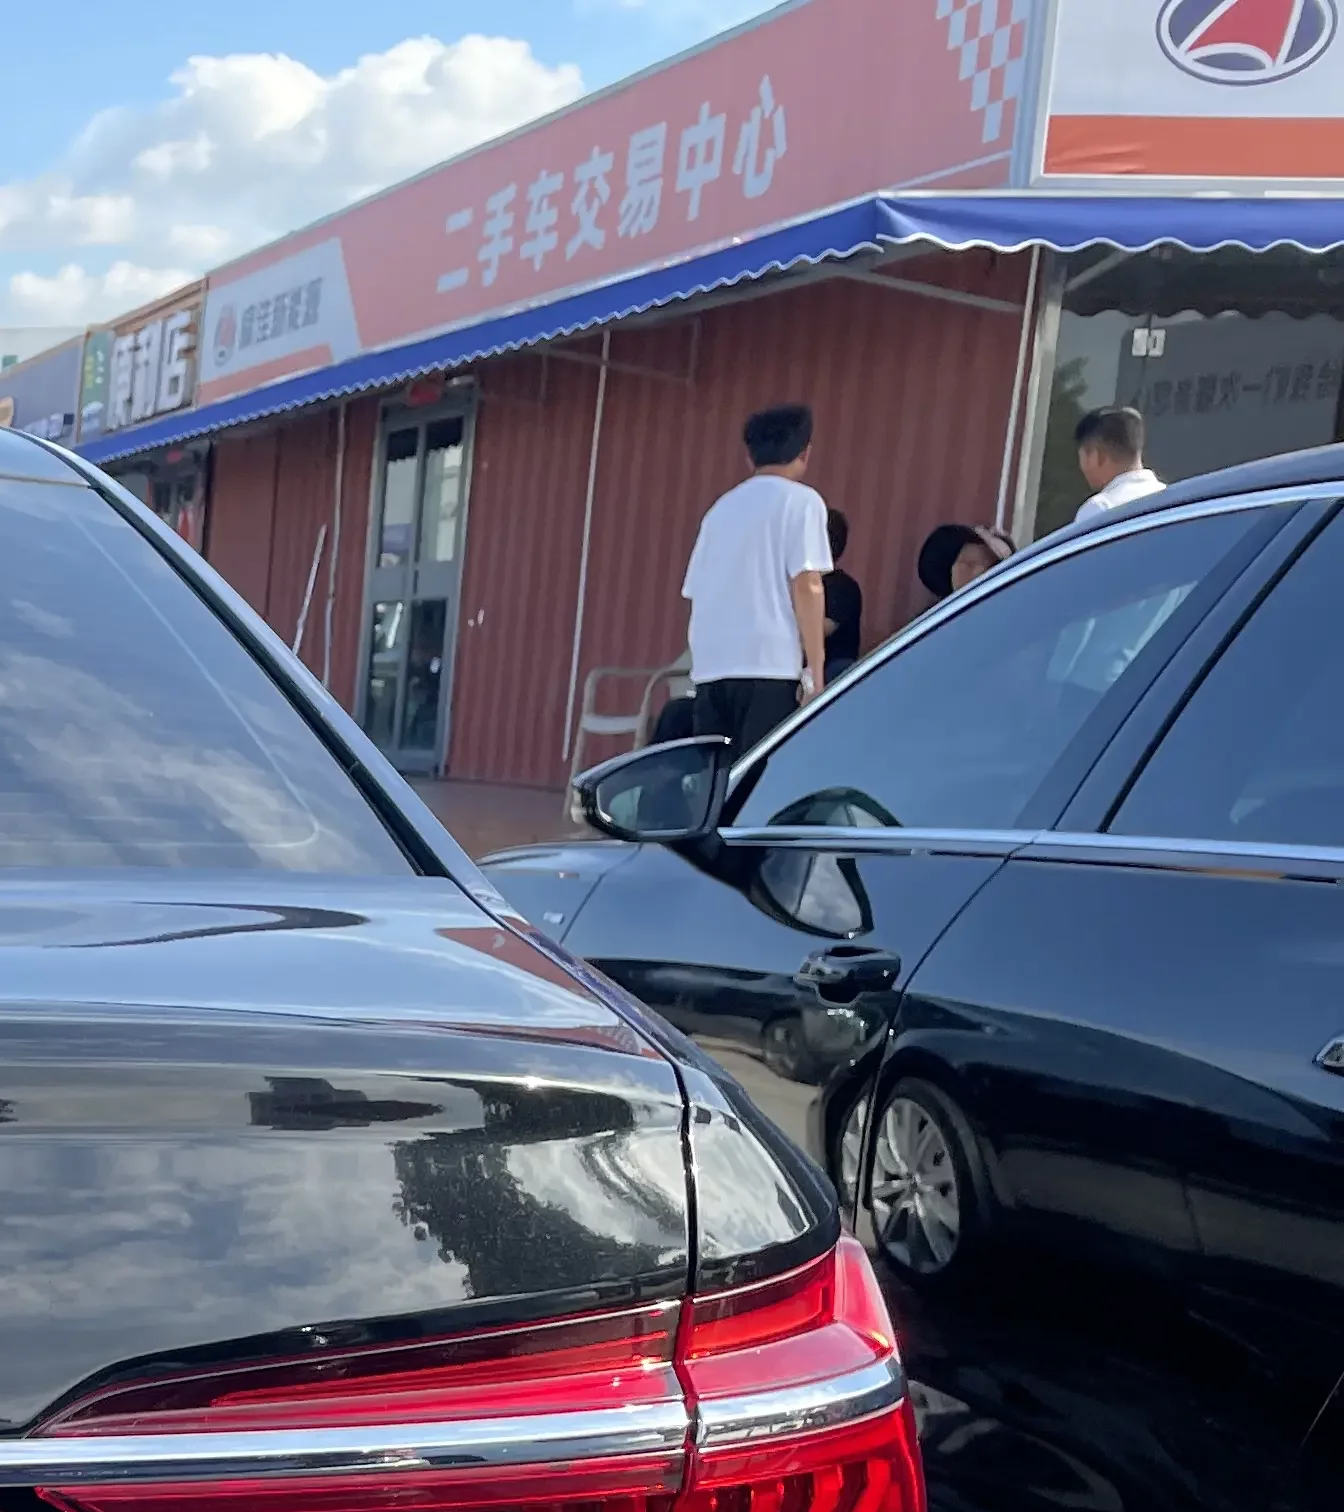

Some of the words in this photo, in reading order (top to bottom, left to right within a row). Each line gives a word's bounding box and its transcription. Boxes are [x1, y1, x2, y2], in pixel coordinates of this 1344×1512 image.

[437, 74, 787, 293] 二手车交易中心
